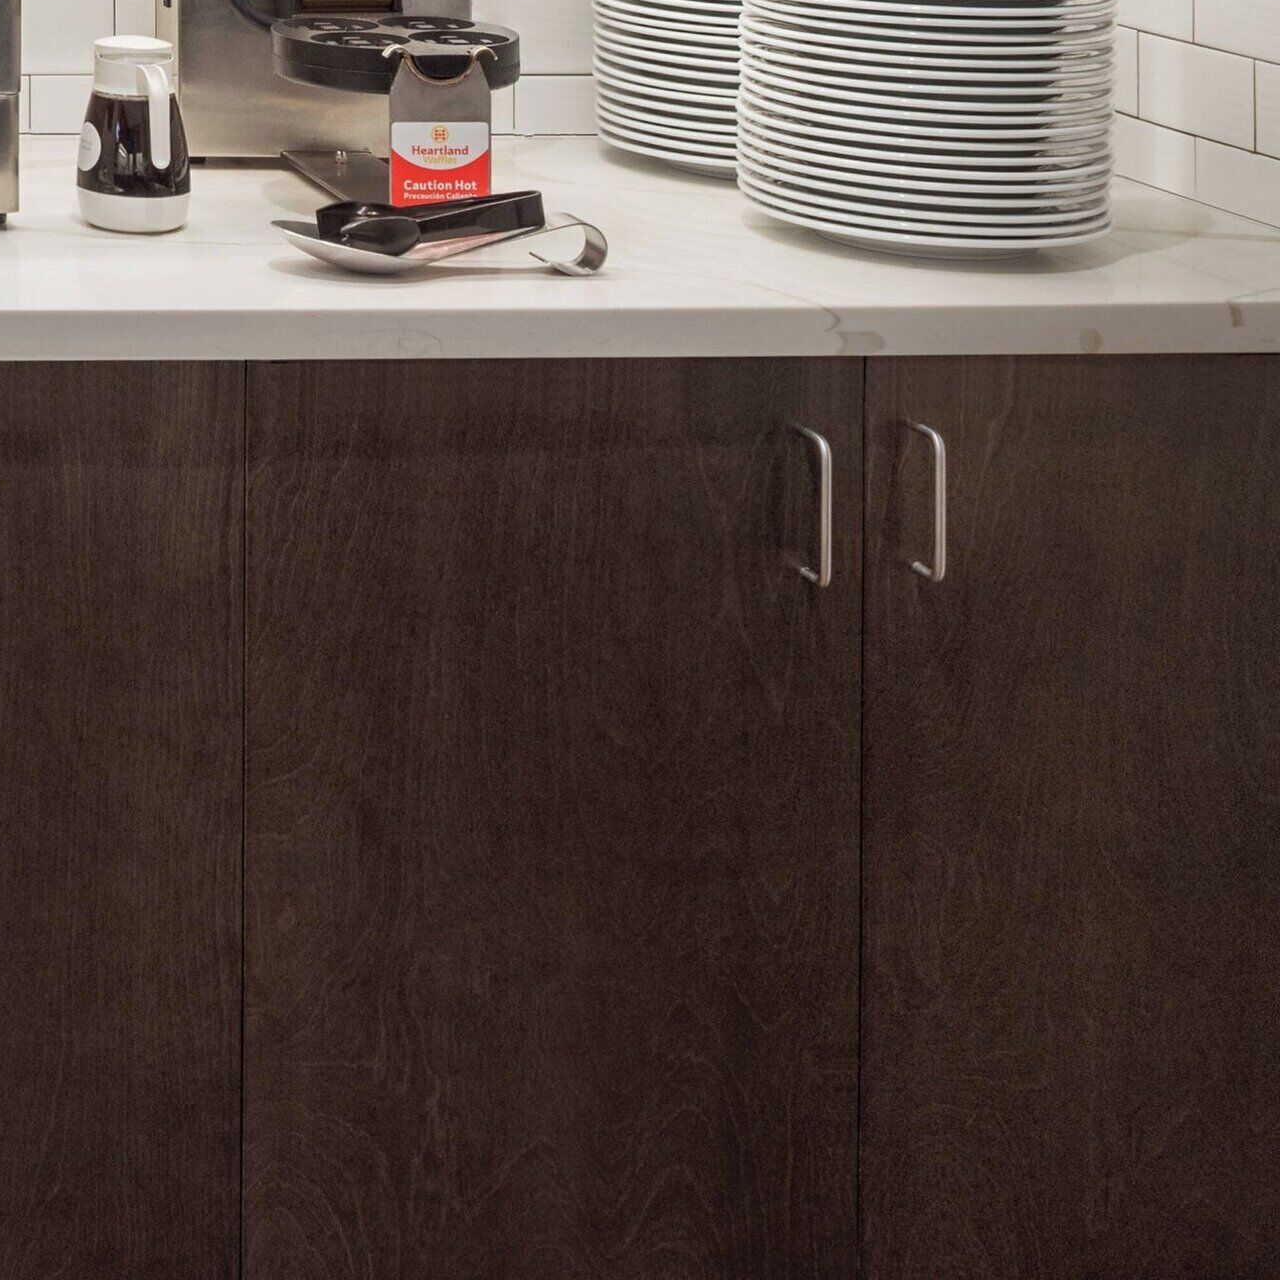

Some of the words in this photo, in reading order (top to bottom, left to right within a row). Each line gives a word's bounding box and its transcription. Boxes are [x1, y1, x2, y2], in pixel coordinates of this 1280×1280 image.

[411, 145, 469, 155] Heartland
[403, 180, 452, 190] Caution
[454, 180, 478, 190] Hot
[403, 192, 445, 200] Precaución
